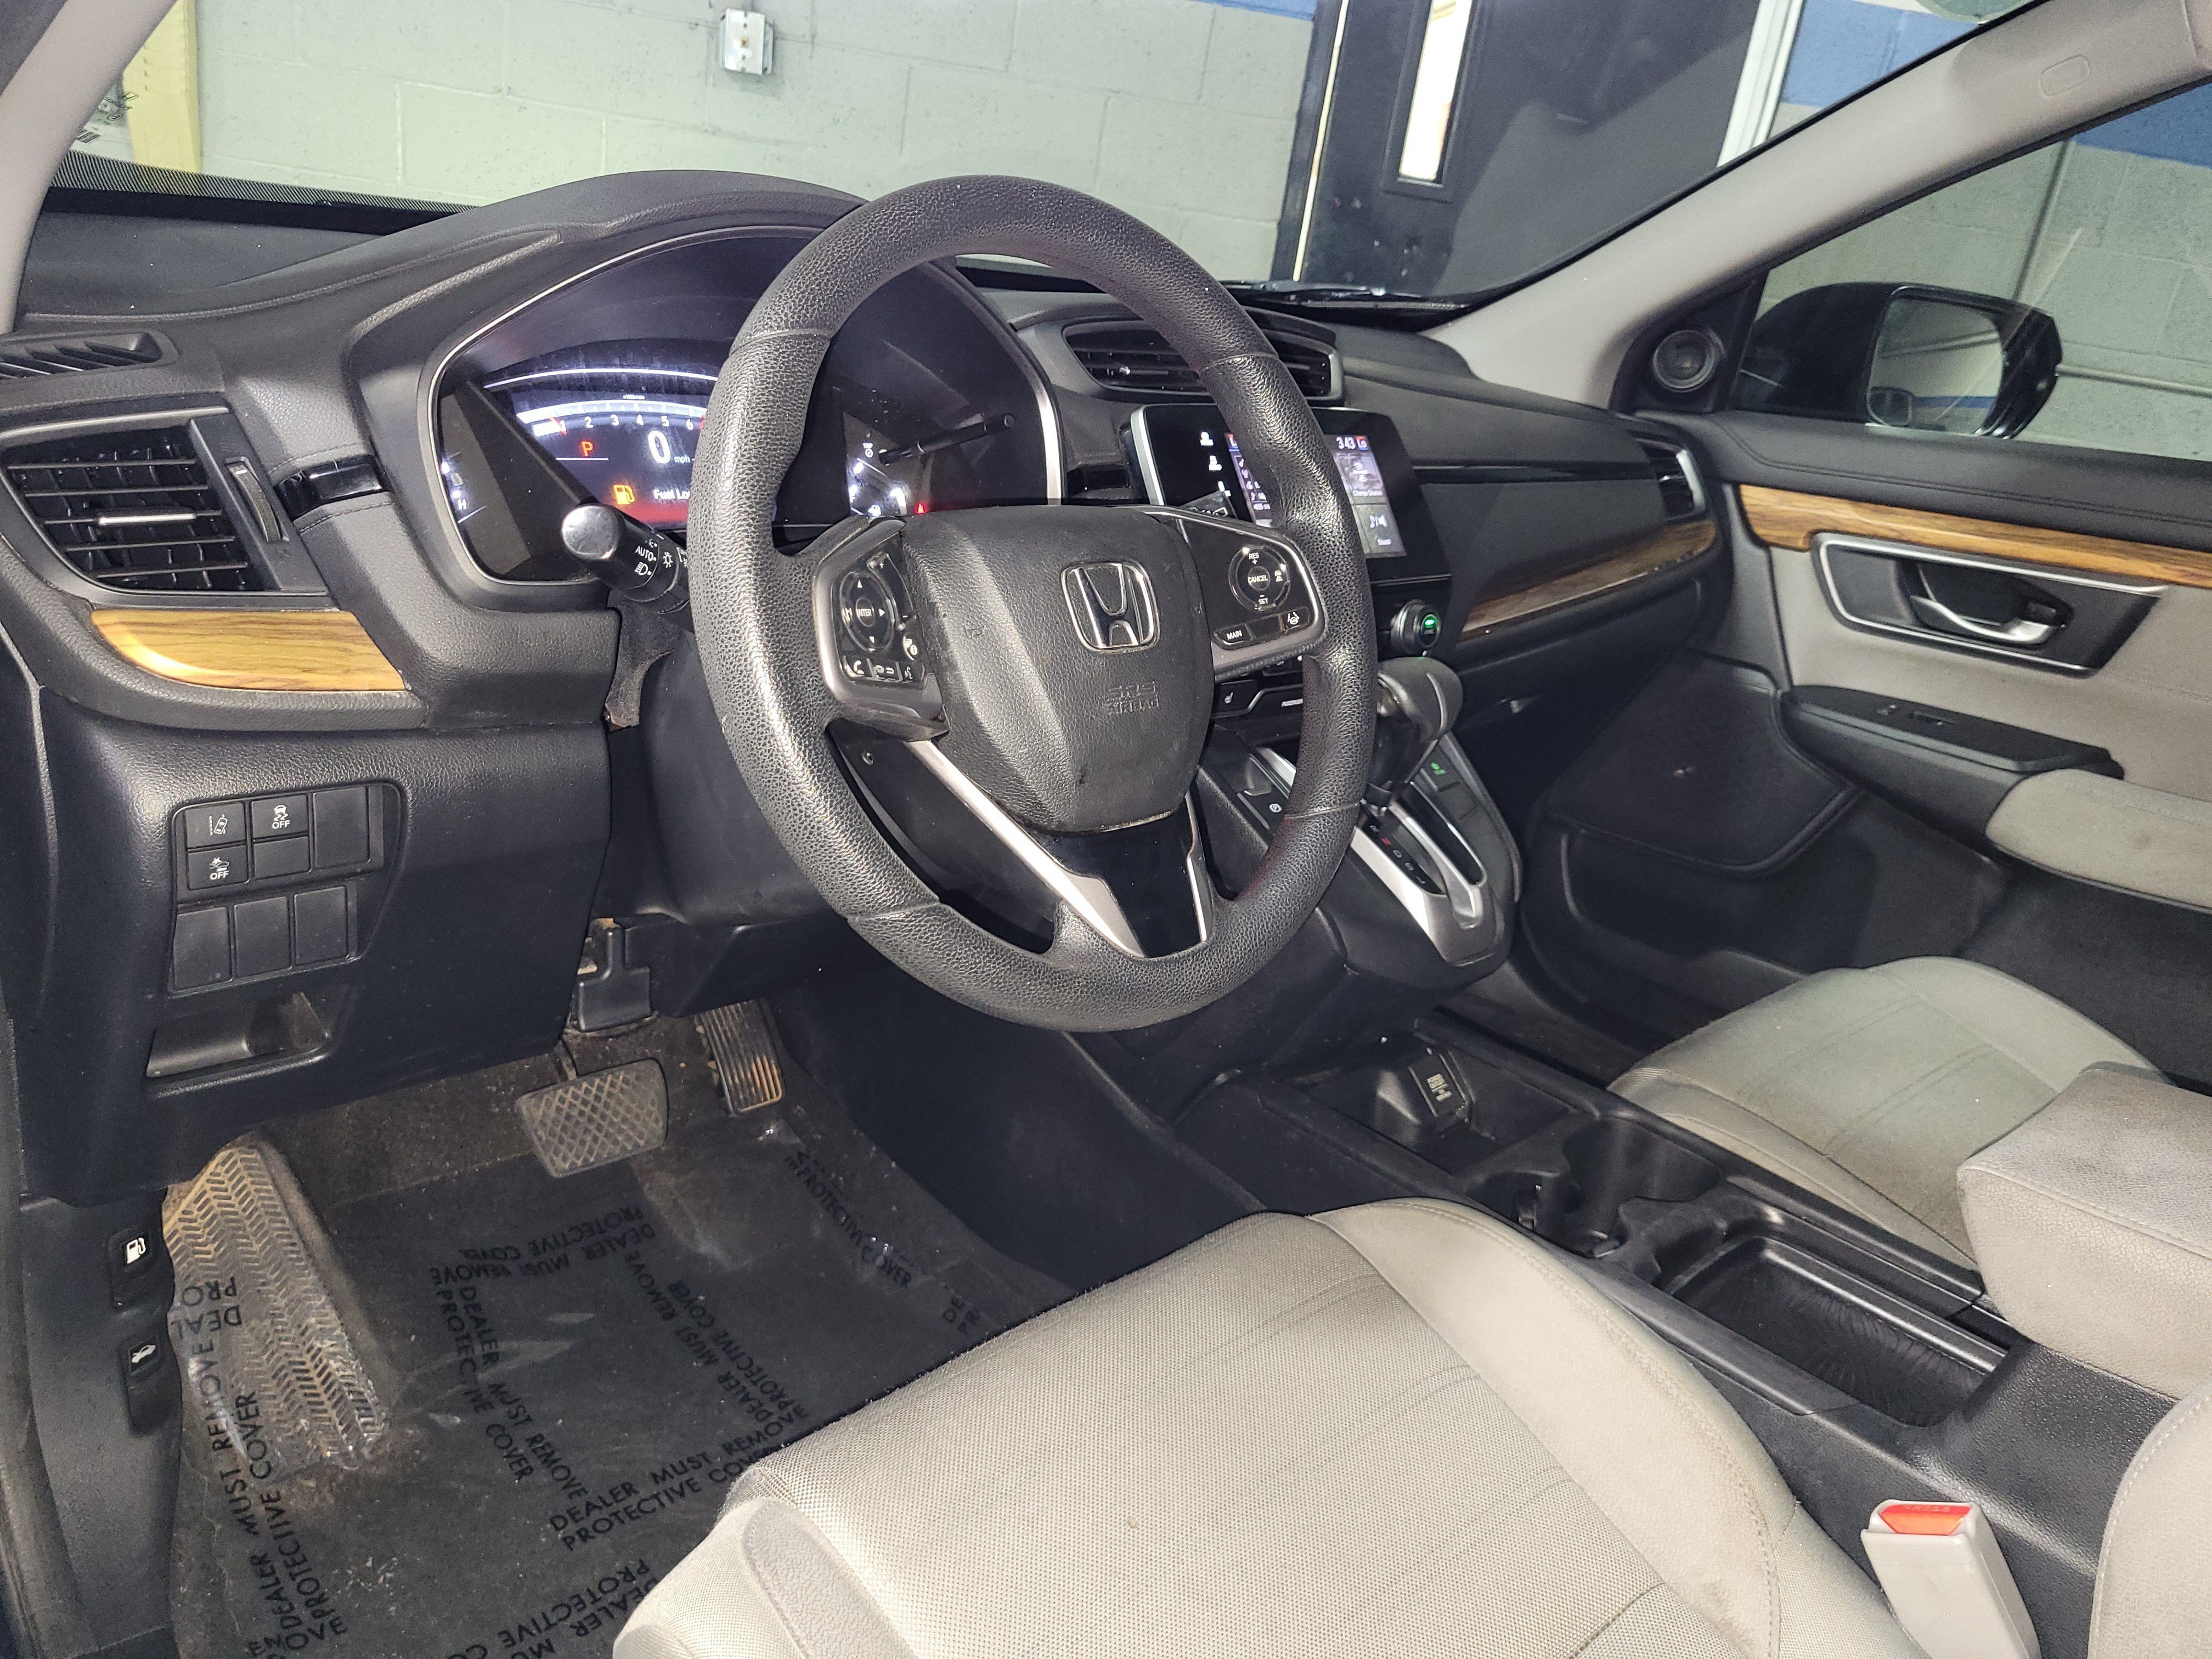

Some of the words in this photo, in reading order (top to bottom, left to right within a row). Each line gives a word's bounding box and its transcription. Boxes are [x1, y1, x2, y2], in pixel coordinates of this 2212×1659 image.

[584, 416, 594, 428] 2
[610, 414, 619, 426] 3
[636, 414, 644, 425] 4
[662, 415, 670, 427] 5
[686, 419, 694, 430] 6
[580, 441, 594, 457] P
[647, 430, 671, 464] 0
[674, 455, 691, 465] mph
[458, 499, 467, 510] H
[653, 489, 675, 500] Fuel
[676, 489, 691, 500] Lo
[635, 545, 654, 562] AUTO
[1248, 574, 1269, 584] CANCEL
[1226, 630, 1243, 640] MAIN
[272, 819, 290, 830] OFF
[210, 870, 229, 880] OFF
[1404, 862, 1414, 871] S
[527, 1206, 645, 1257] PROTECTIVE
[582, 1223, 656, 1261] DEALER
[458, 1285, 500, 1367] DEALER
[523, 1432, 590, 1501] REMOVE
[716, 1370, 775, 1423] DEALER
[234, 1390, 274, 1480] COVER
[485, 1423, 535, 1481] COVER
[549, 1481, 640, 1532] DEALER
[648, 1451, 714, 1485] MUST
[720, 1403, 811, 1456] REMOVE
[561, 1477, 703, 1553] PROTECTIVE
[249, 1552, 303, 1629] DEALER
[496, 1558, 651, 1649] PROTECTIVE
